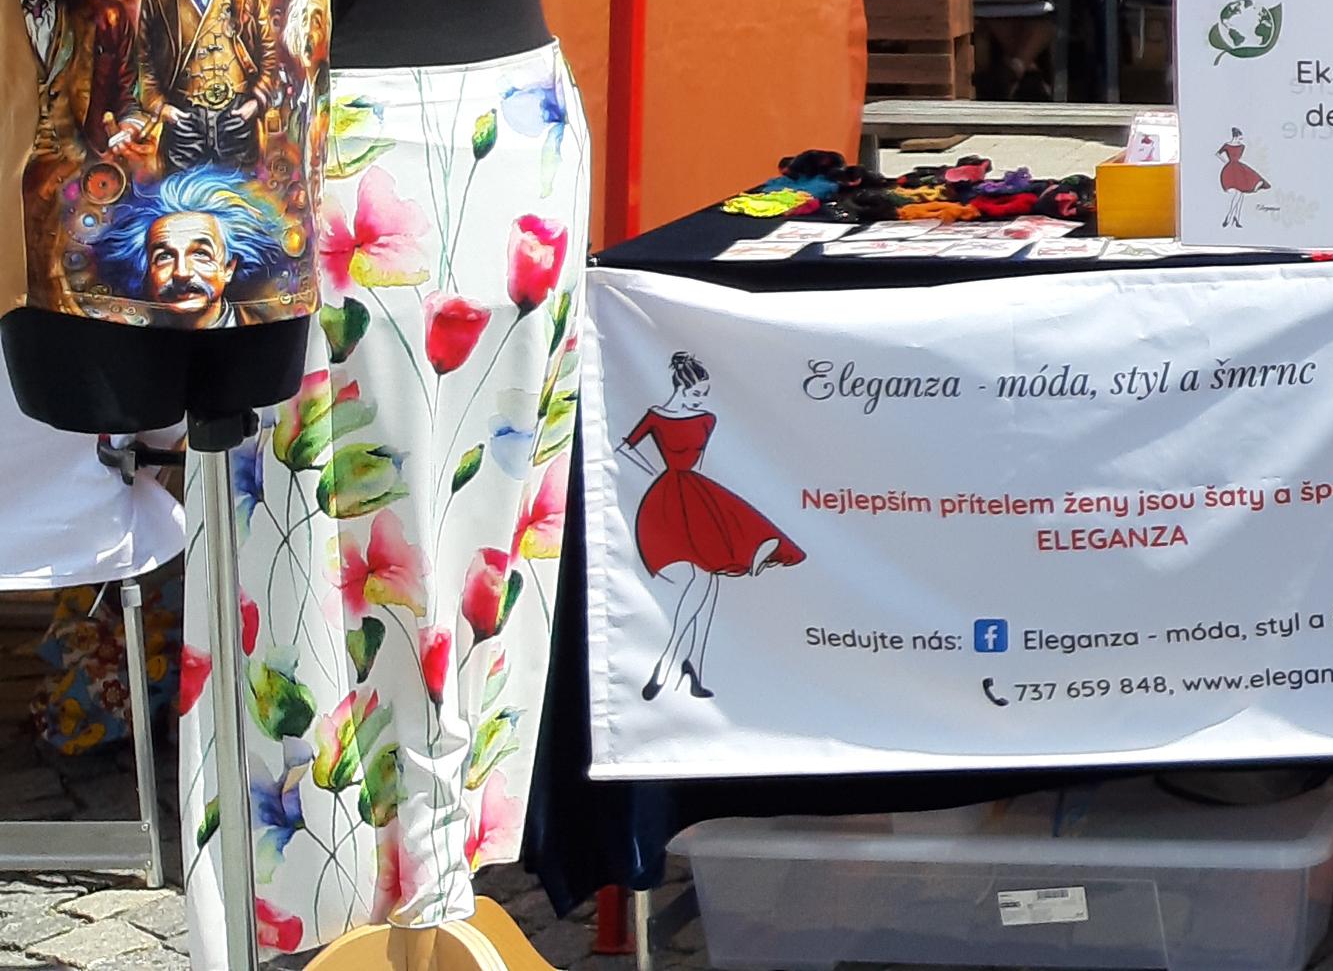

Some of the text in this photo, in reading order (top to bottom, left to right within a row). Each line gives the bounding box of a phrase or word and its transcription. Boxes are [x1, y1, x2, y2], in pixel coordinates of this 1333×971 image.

[802, 359, 962, 415] Eleganza
[996, 364, 1098, 401] móda,
[1109, 361, 1173, 401] styl
[1179, 369, 1201, 392] a
[1209, 358, 1317, 390] šmrnc
[801, 488, 932, 516] Nejlepším
[940, 492, 1055, 519] přítelem
[1063, 492, 1130, 518] ženy
[1137, 490, 1196, 516] jsou
[1204, 485, 1265, 511] šaty
[1273, 487, 1292, 505] a
[1036, 524, 1189, 551] ELEGANZA
[805, 626, 904, 653] Sledujte
[912, 630, 963, 651] nás:
[1023, 629, 1140, 654] Eleganza
[1166, 620, 1248, 645] móda,
[1255, 612, 1301, 638] styl
[1308, 613, 1325, 629] a
[1013, 682, 1057, 702] 737
[1066, 679, 1111, 699] 659
[1119, 675, 1175, 696] 848,
